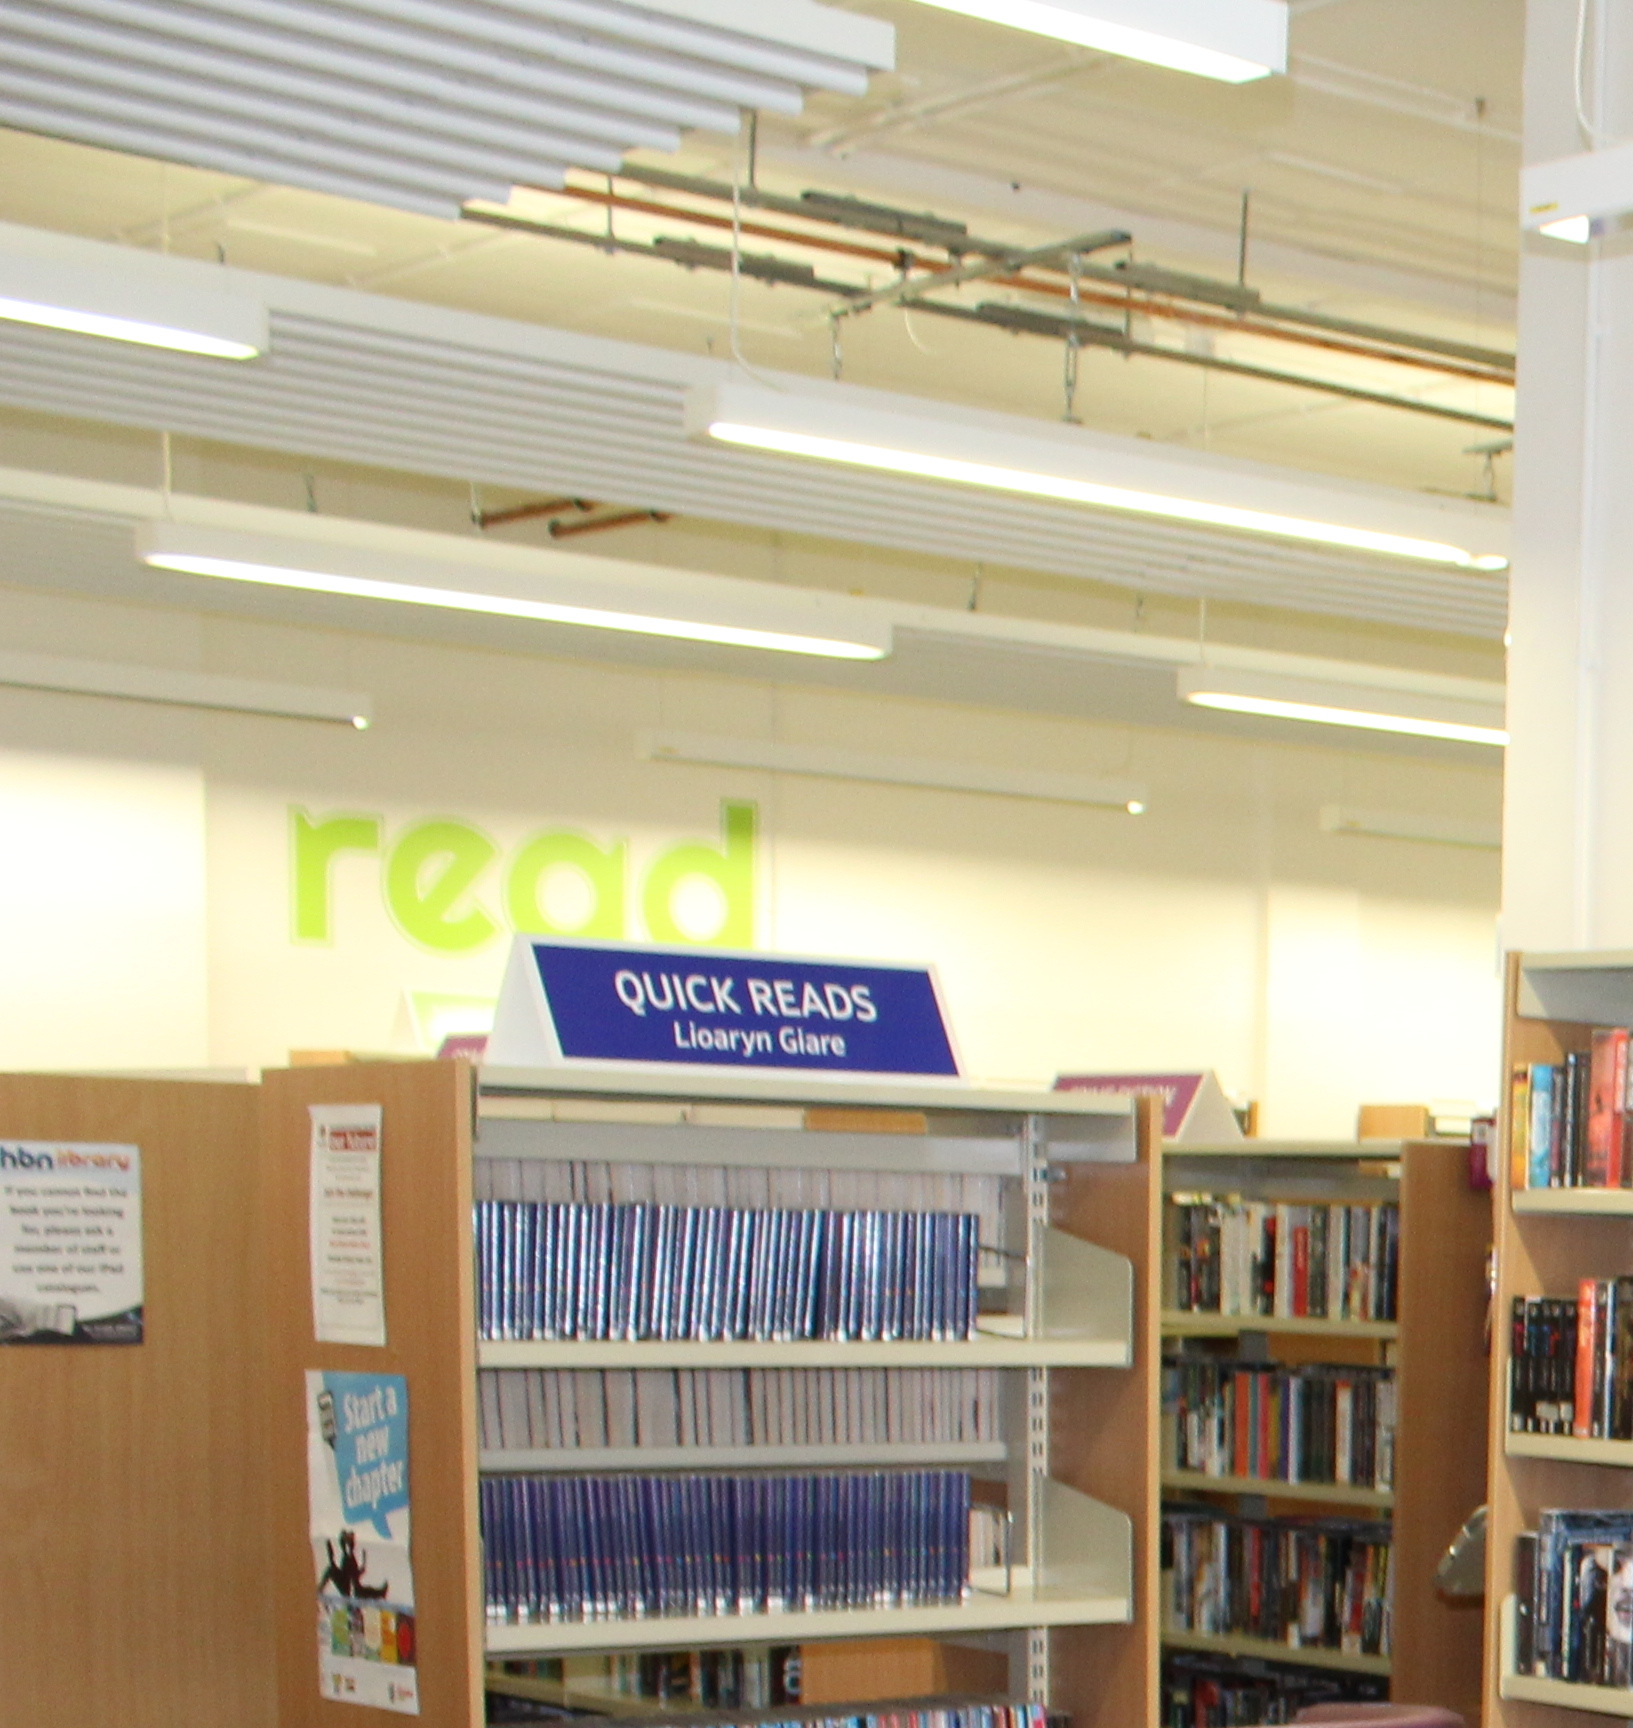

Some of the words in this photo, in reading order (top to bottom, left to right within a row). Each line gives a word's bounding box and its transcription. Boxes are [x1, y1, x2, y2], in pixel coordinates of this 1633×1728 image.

[286, 798, 757, 953] read
[614, 969, 742, 1015] QUICK
[747, 978, 877, 1022] READS
[673, 1020, 772, 1058] Lioaryn
[779, 1025, 846, 1057] Glare
[343, 1385, 385, 1433] Start
[385, 1385, 398, 1416] a
[354, 1425, 390, 1466] new
[345, 1459, 405, 1511] chapter
